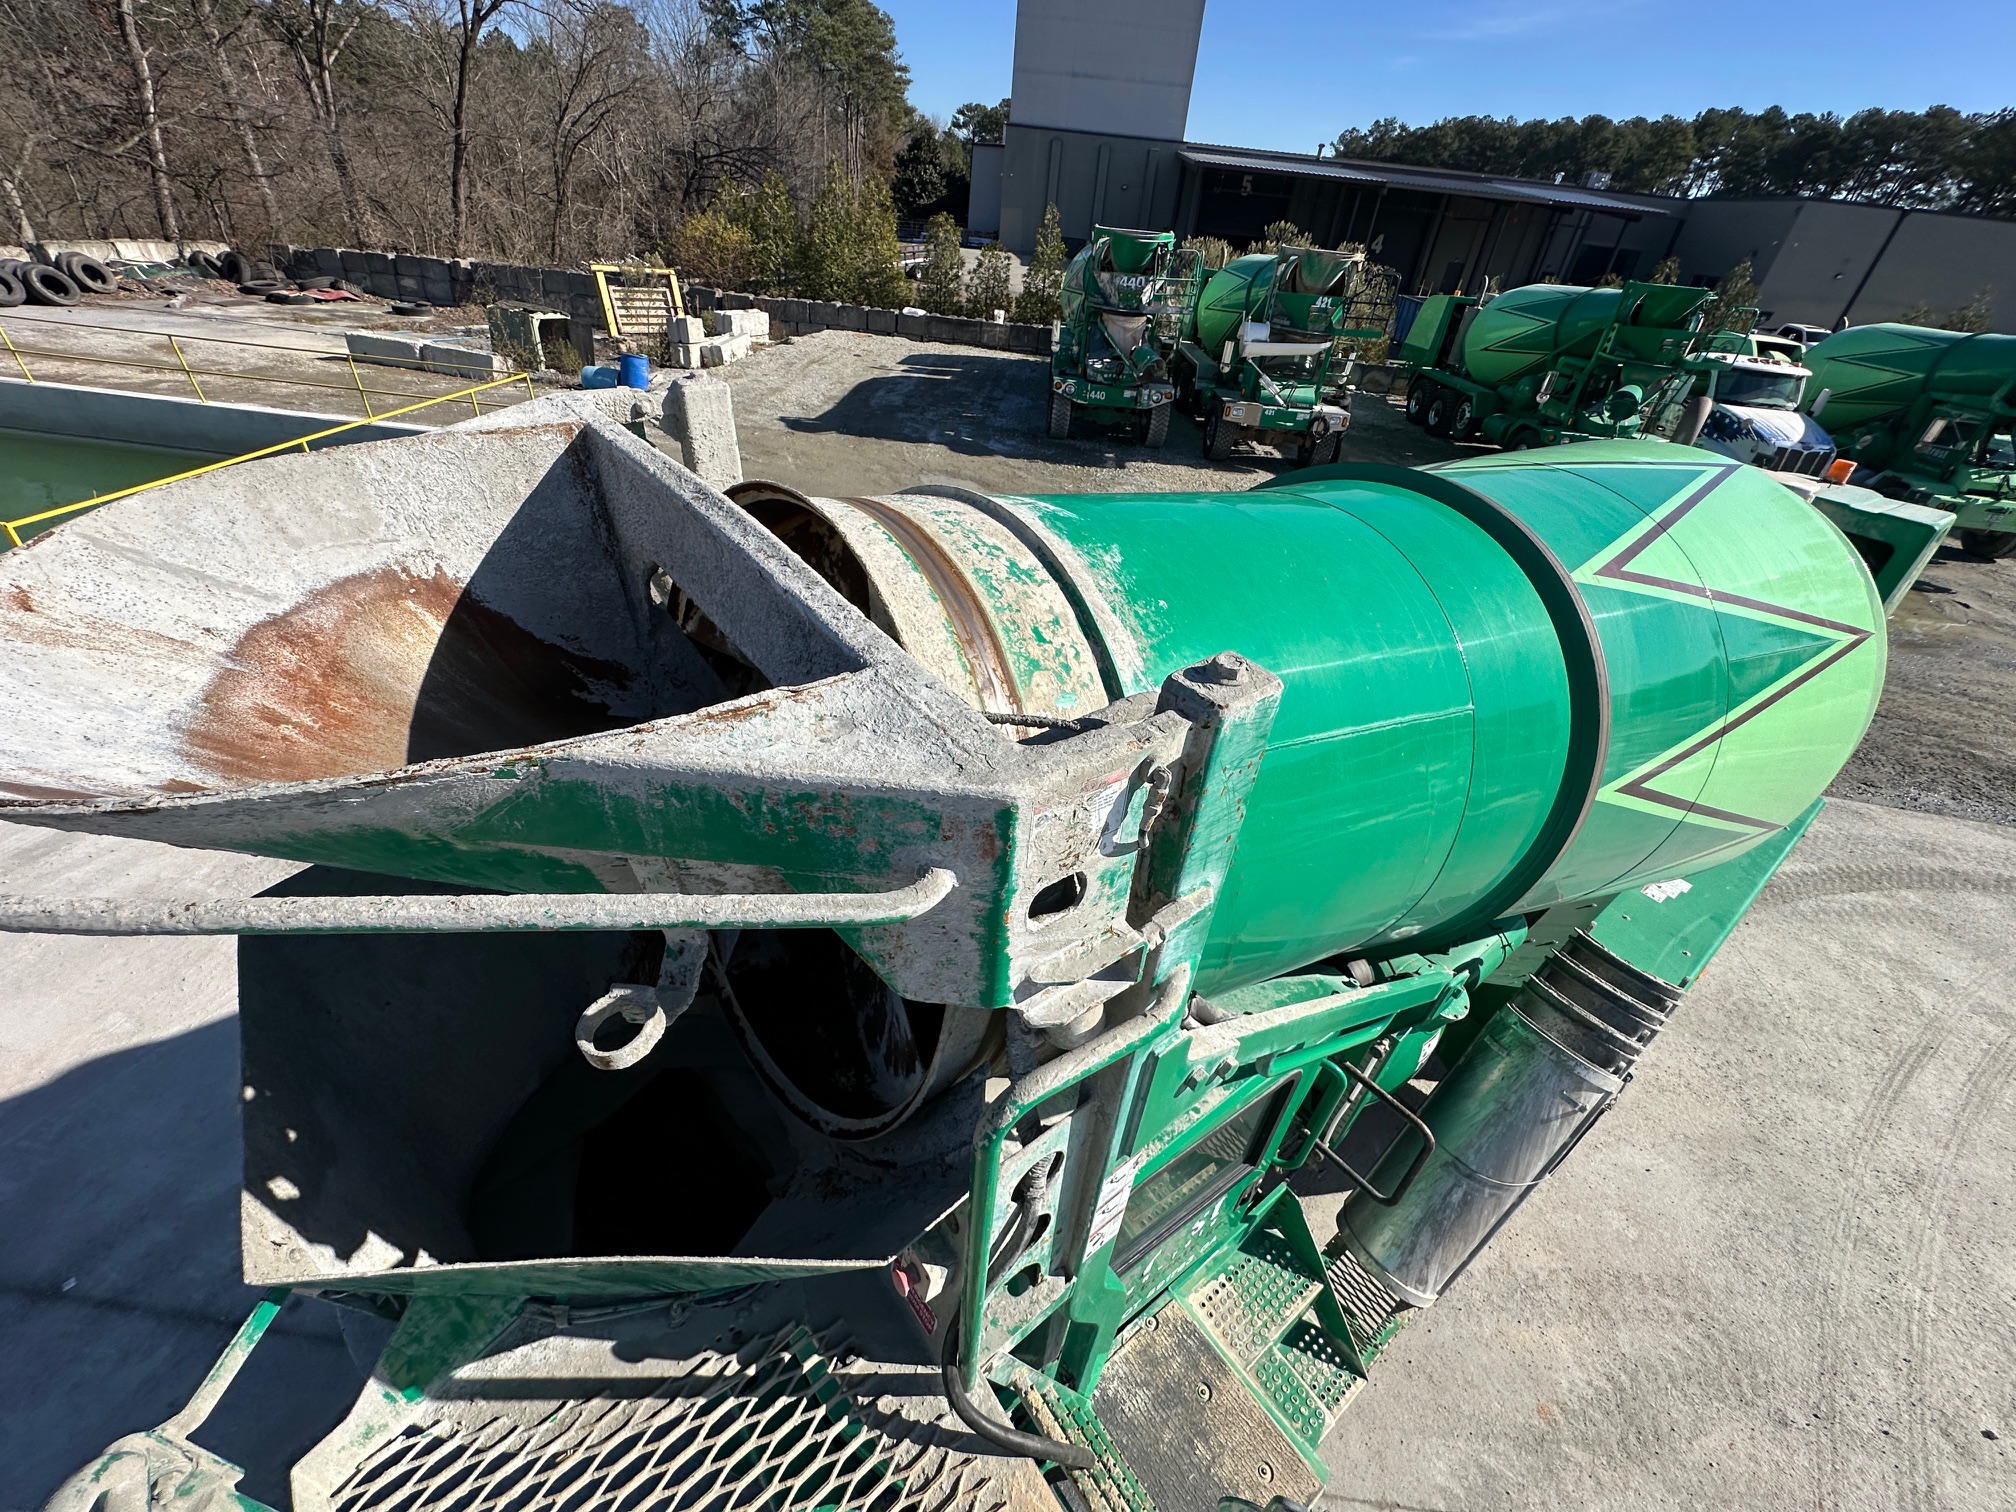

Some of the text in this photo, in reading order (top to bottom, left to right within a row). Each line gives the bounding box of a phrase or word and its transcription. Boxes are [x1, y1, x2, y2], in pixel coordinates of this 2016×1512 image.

[1241, 175, 1253, 196] 5
[1371, 234, 1385, 254] 4
[1315, 296, 1332, 308] 421
[1122, 1299, 1142, 1319] OT
